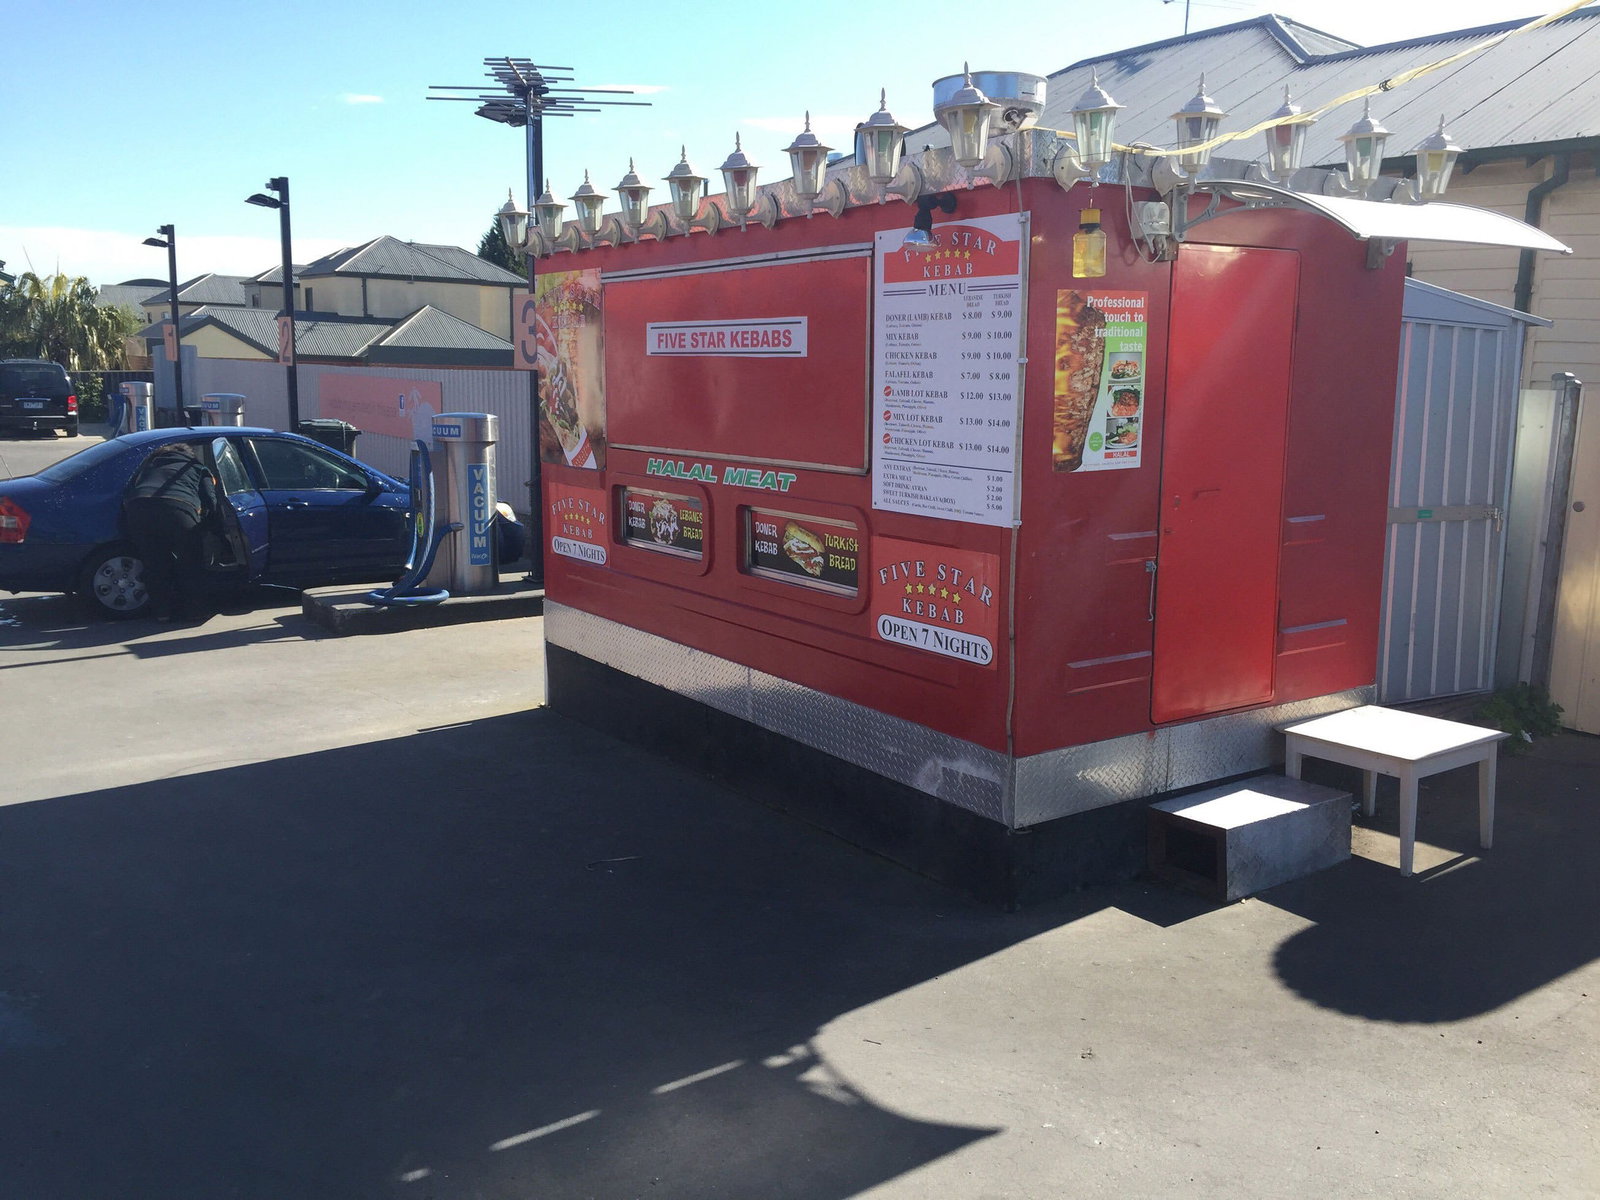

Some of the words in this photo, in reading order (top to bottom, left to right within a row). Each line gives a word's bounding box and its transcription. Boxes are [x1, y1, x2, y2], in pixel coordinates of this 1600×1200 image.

[904, 233, 942, 263] FE
[952, 231, 997, 256] STAR
[923, 263, 973, 277] KEBAB
[928, 283, 967, 296] MENU
[1087, 296, 1144, 308] Professional
[930, 312, 952, 320] KEBAB
[1104, 311, 1131, 322] touch
[1133, 312, 1144, 322] to
[521, 300, 537, 365] 3
[657, 332, 686, 349] FIVE
[690, 331, 726, 348] STAR
[730, 329, 792, 348] KEBABS
[1094, 326, 1143, 337] traditional
[281, 321, 291, 362] 2
[1120, 342, 1143, 352] taste
[891, 389, 910, 397] LAMB
[926, 390, 948, 398] KEBAB
[893, 413, 905, 421] MIX
[920, 415, 943, 423] KEBAB
[890, 437, 918, 445] CHICKEN
[918, 439, 932, 447] LOT
[932, 440, 954, 449] KEBAB
[646, 457, 718, 483] HALAL
[722, 466, 797, 492] MEAT
[473, 468, 487, 548] VACUUM
[552, 497, 574, 515] FIVE
[578, 499, 605, 525] STAR
[628, 500, 645, 514] DONER
[563, 523, 592, 539] KEBAB
[628, 517, 646, 529] KEBAB
[755, 522, 778, 538] DONER
[683, 526, 703, 541] BREAD
[554, 538, 571, 553] OPEN
[573, 543, 577, 555] 7
[578, 544, 605, 562] NIGHTS
[755, 540, 778, 556] KEBAB
[829, 554, 856, 571] BREAD
[879, 561, 926, 585] FIVE
[936, 563, 993, 607] STAR
[902, 598, 964, 625] KEBAB
[881, 618, 918, 643] OPEN
[921, 628, 929, 645] 7
[933, 630, 989, 661] NIGHTS
